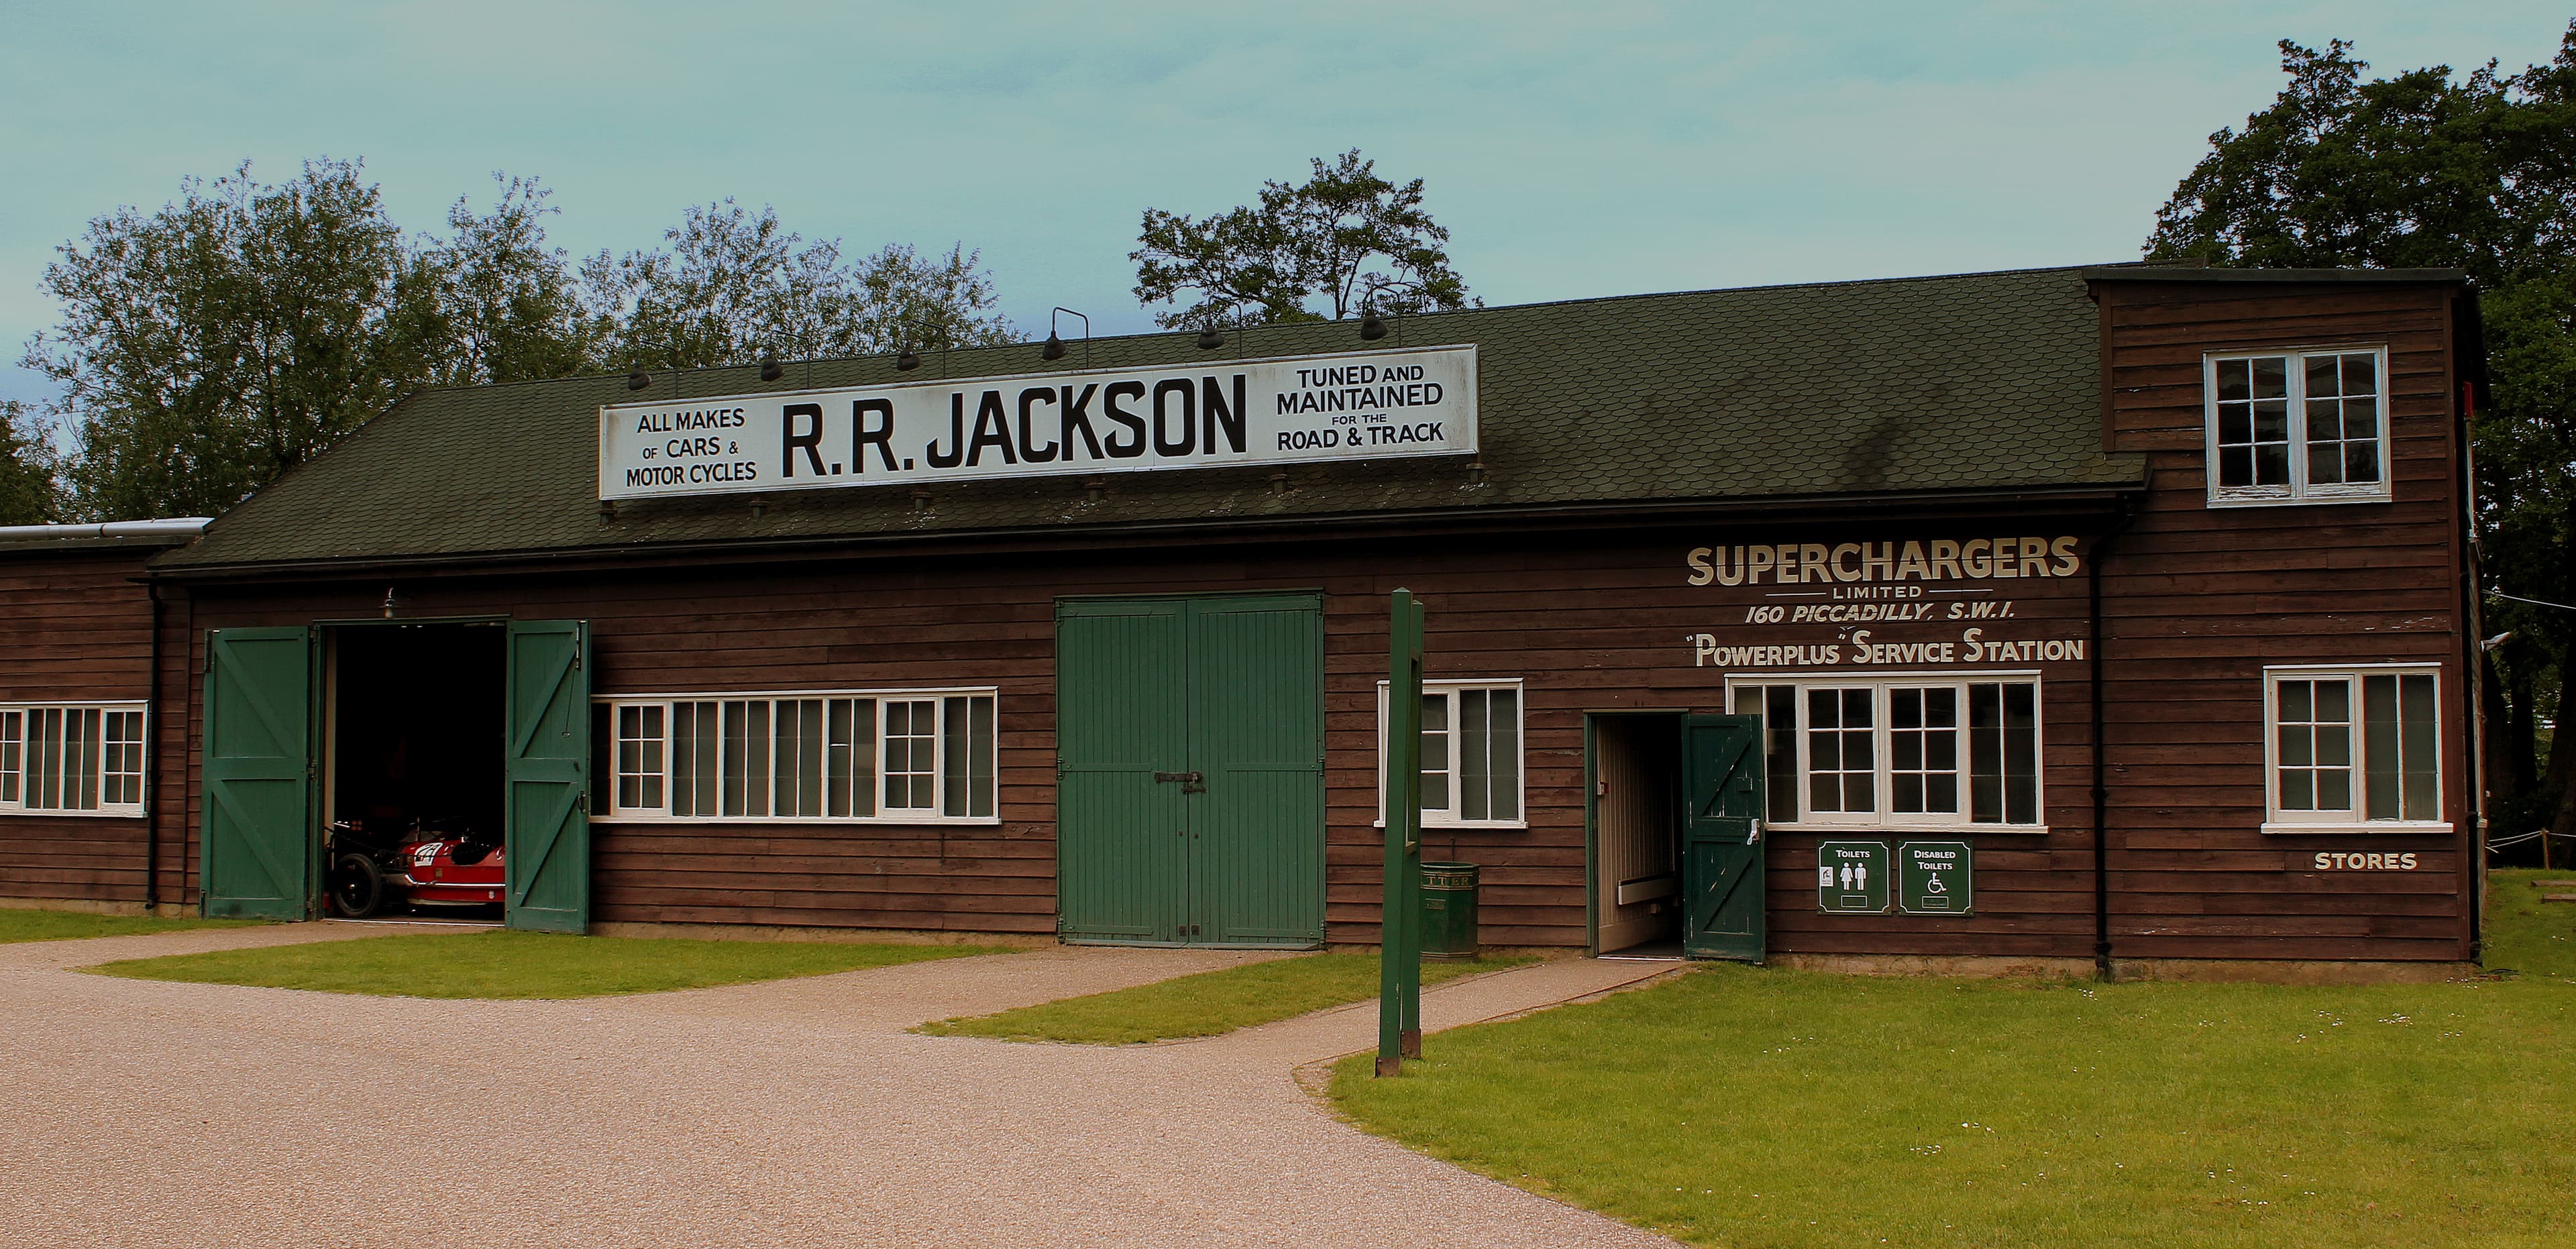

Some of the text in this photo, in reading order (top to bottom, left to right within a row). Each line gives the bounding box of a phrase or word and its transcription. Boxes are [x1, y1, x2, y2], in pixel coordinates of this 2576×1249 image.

[1296, 365, 1424, 389] TUNED AND
[1277, 382, 1444, 415] MAINTAINED
[637, 408, 745, 433] ALL MAKES
[926, 374, 1247, 469] JACKSON
[1332, 413, 1387, 426] FOR THE
[643, 436, 739, 459] OF CARS &
[1277, 422, 1445, 451] ROAD & TRACK
[627, 461, 757, 487] MOTOR CYCLES
[1686, 536, 2080, 586] SUPERCHARGERS
[1833, 586, 1922, 599] LIMITED
[1745, 606, 1784, 624] 160
[1791, 603, 1934, 622] PICCADILLY,
[2314, 852, 2417, 870] STORES
